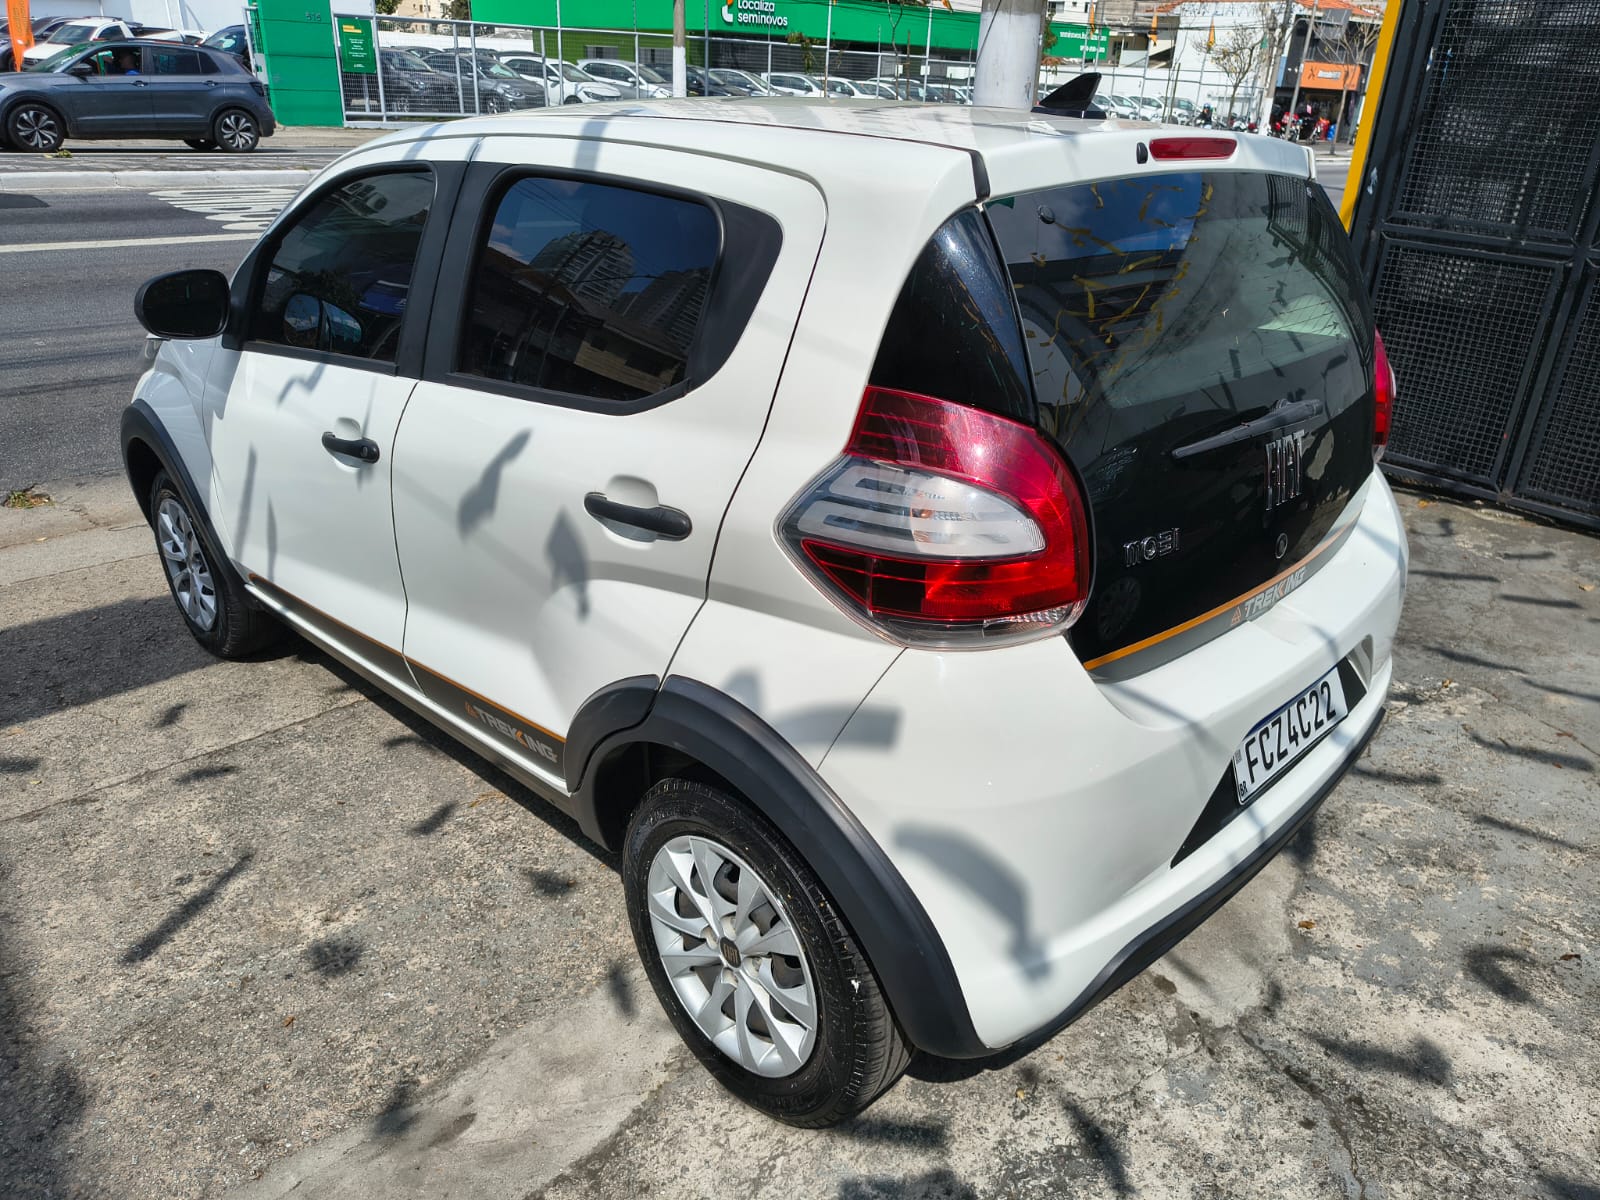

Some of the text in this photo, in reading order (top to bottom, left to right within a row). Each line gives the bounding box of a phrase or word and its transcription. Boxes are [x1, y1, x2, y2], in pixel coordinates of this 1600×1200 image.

[737, 0, 775, 12] Localiza
[737, 12, 788, 26] seminovos
[1265, 429, 1305, 511] FIAT
[1244, 566, 1306, 618] TREKKING
[472, 704, 558, 763] TREKKING
[1244, 680, 1336, 784] FCZ4C22
